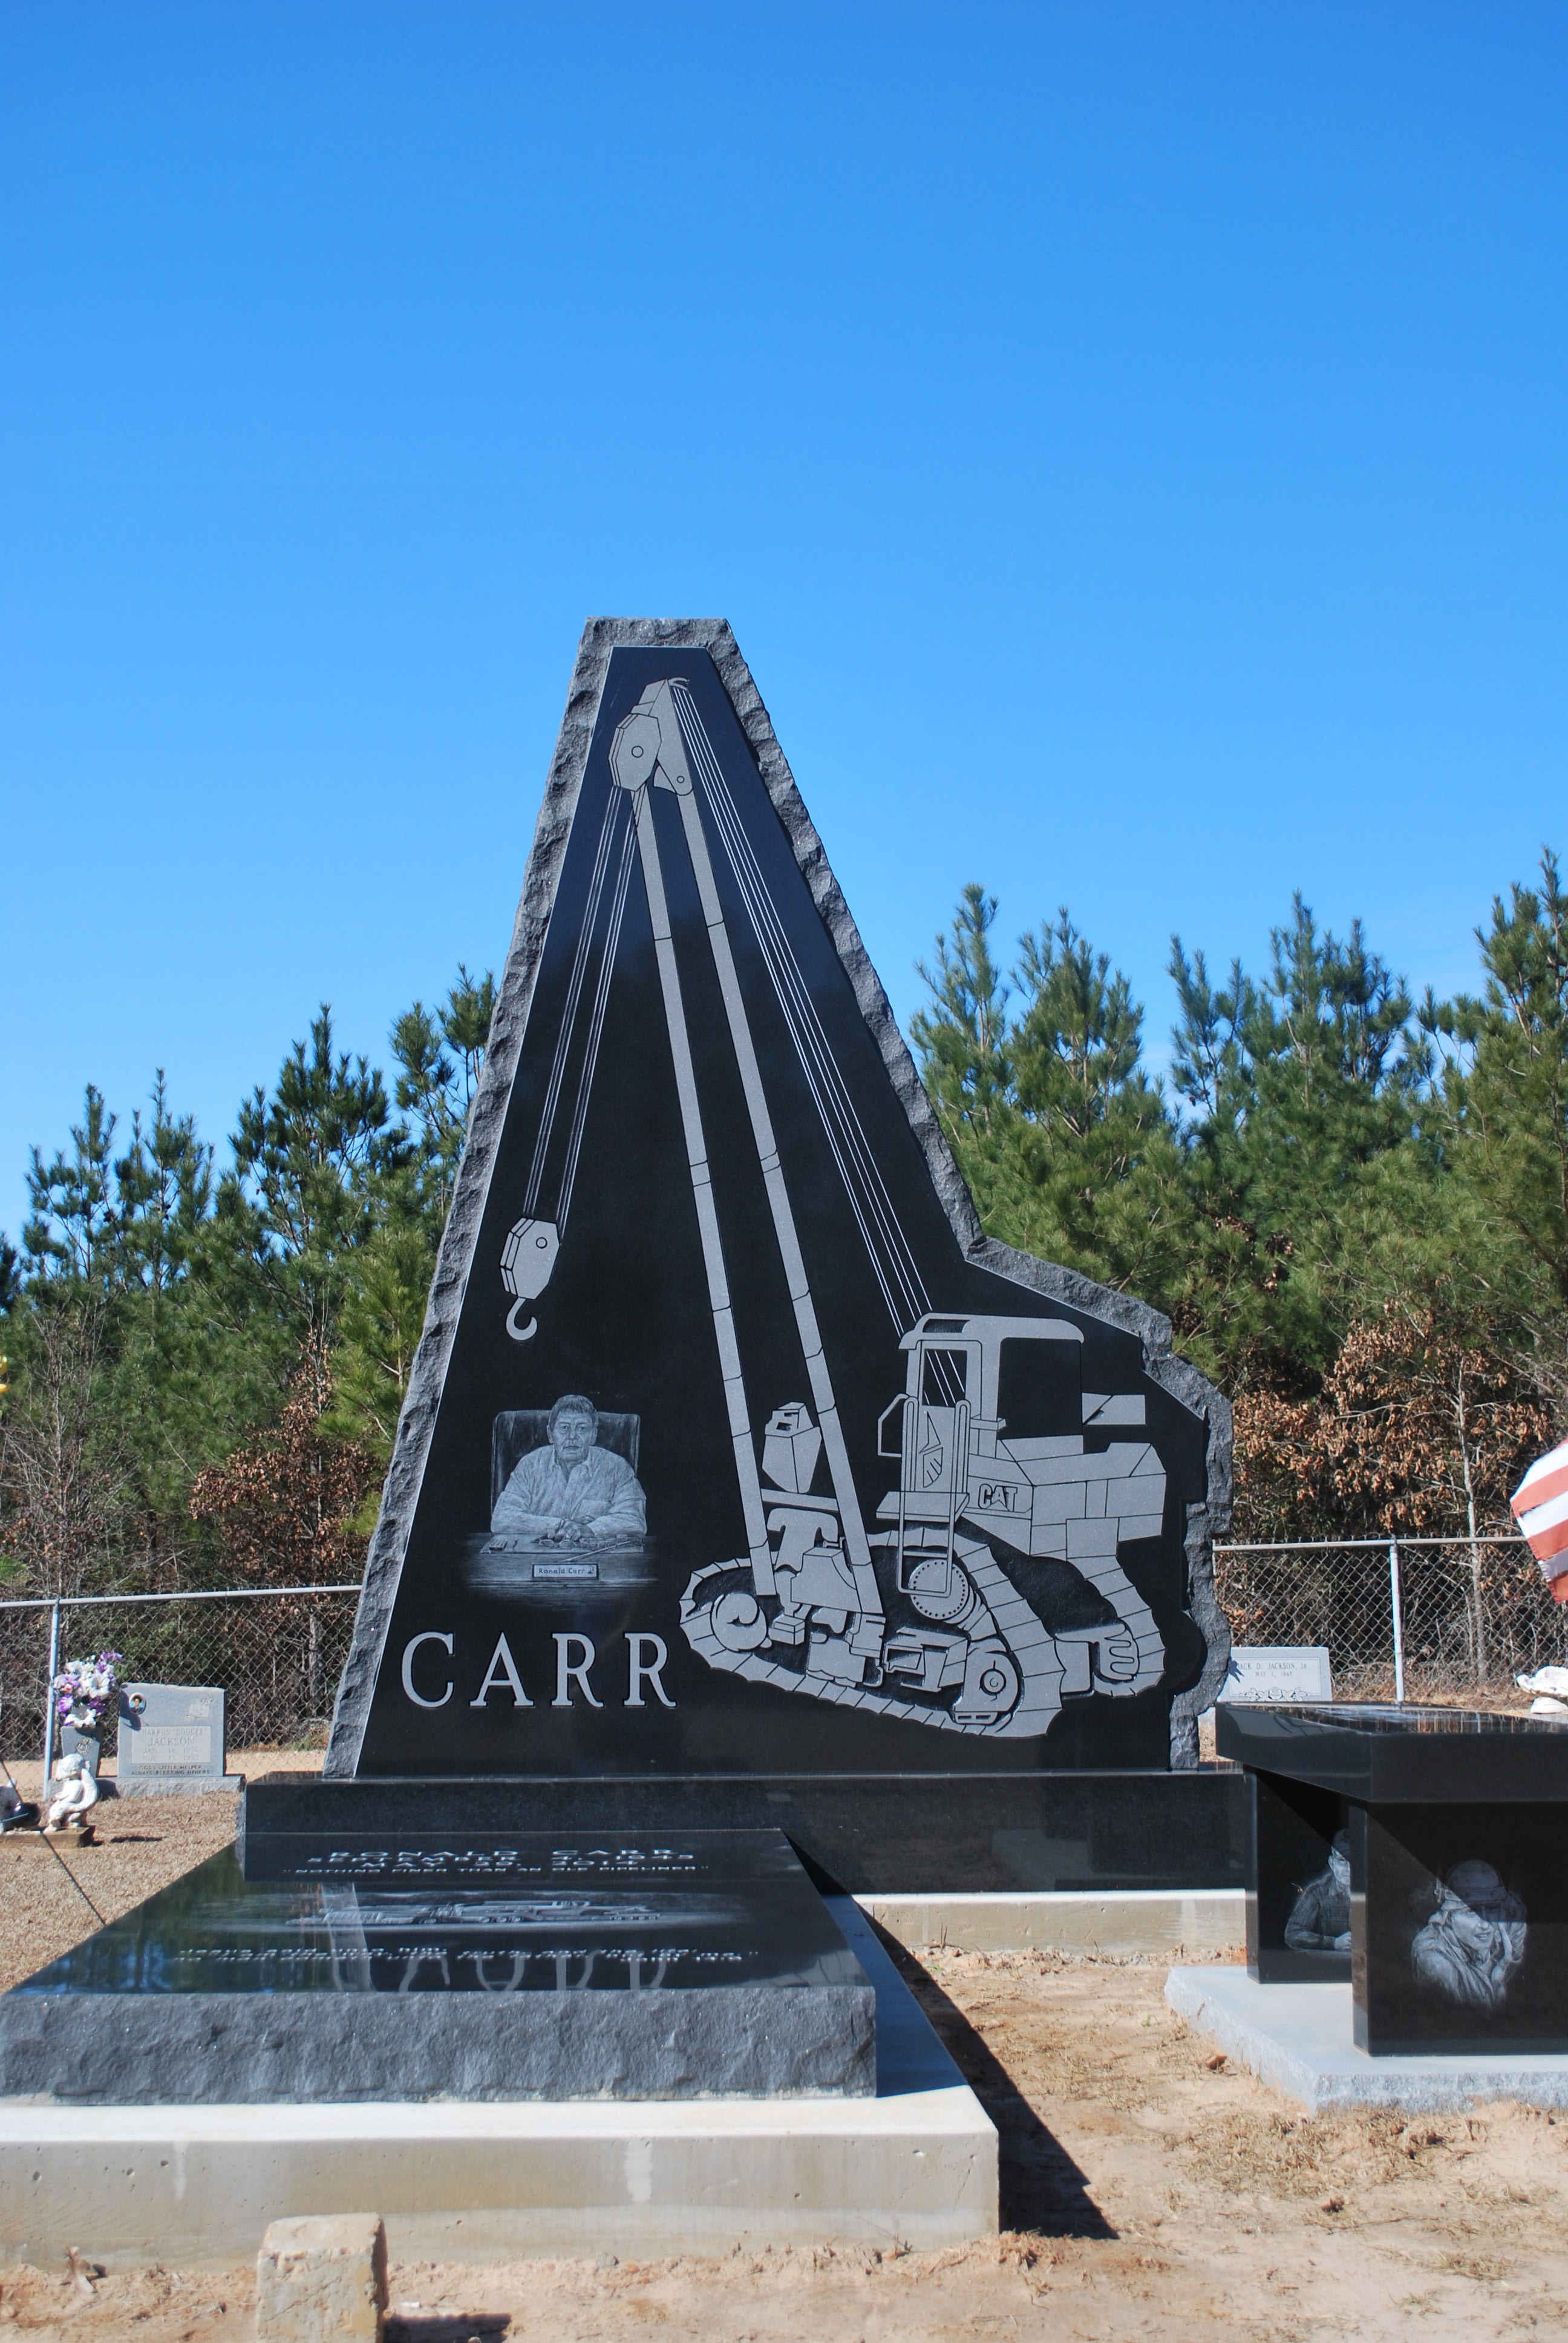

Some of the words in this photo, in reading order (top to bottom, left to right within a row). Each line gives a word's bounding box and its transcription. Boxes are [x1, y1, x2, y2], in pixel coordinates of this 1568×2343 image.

[978, 1483, 1018, 1512] CAT
[402, 1631, 678, 1708] CARR
[148, 1737, 194, 1746] JACKSON
